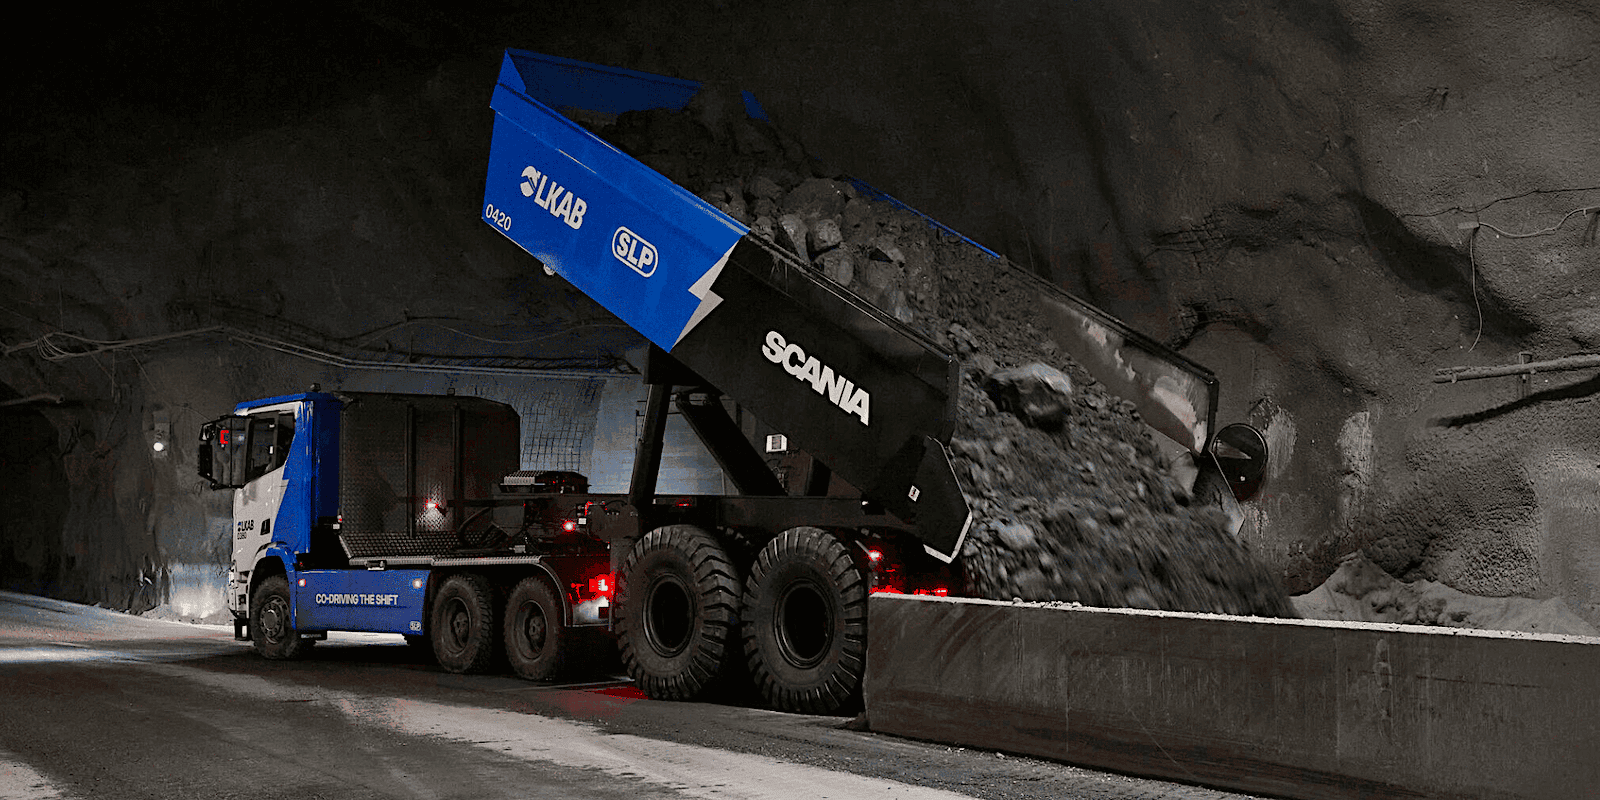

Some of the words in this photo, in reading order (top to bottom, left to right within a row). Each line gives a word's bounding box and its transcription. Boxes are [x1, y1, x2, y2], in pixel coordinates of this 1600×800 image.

[485, 203, 512, 231] 0420
[534, 174, 587, 230] LKAB
[616, 232, 654, 269] SLP
[762, 330, 870, 426] SCANIA
[241, 519, 254, 531] LKAB
[315, 593, 359, 605] CO-DRIVING
[359, 594, 375, 605] THE
[375, 594, 398, 605] SHIFT
